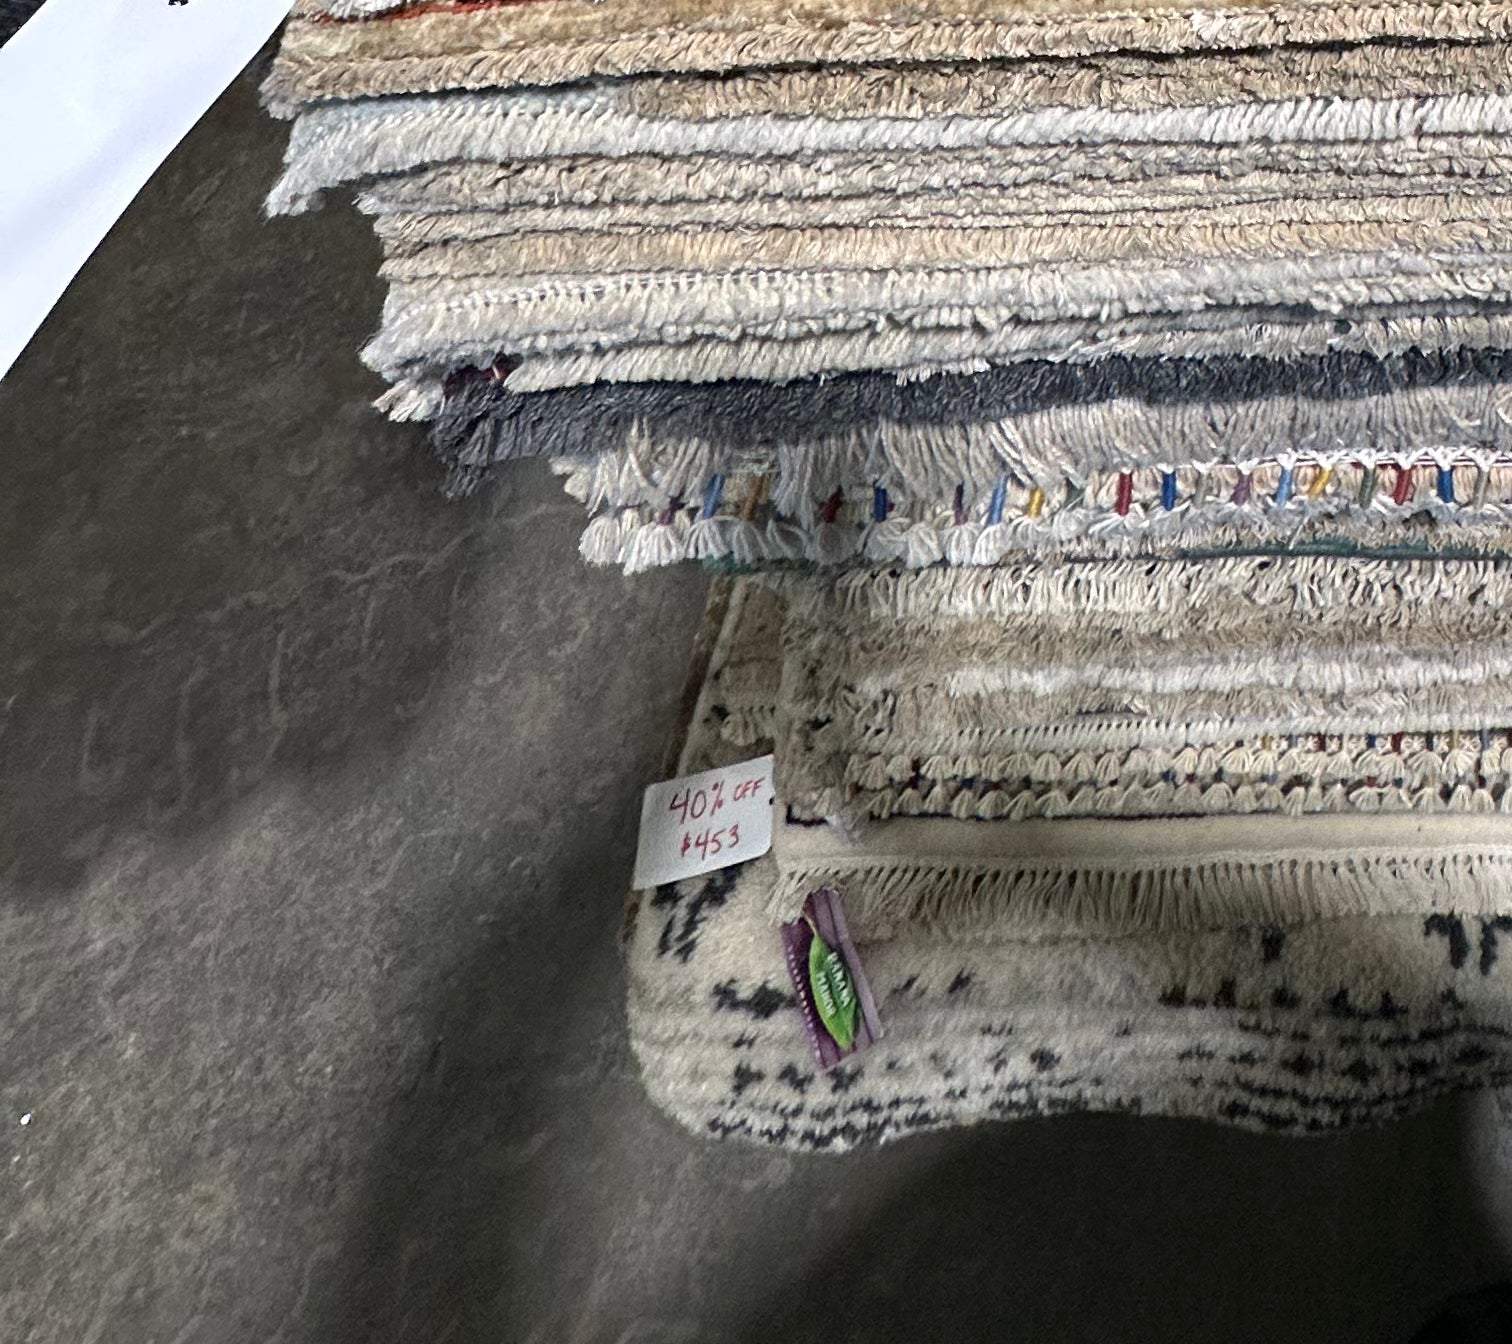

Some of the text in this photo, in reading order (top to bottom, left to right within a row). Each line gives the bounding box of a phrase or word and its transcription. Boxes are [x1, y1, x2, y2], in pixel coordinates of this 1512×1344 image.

[668, 776, 766, 824] 40% OFF
[680, 823, 740, 860] $453
[815, 970, 837, 1018] MANOR
[826, 951, 851, 1009] BANANA
